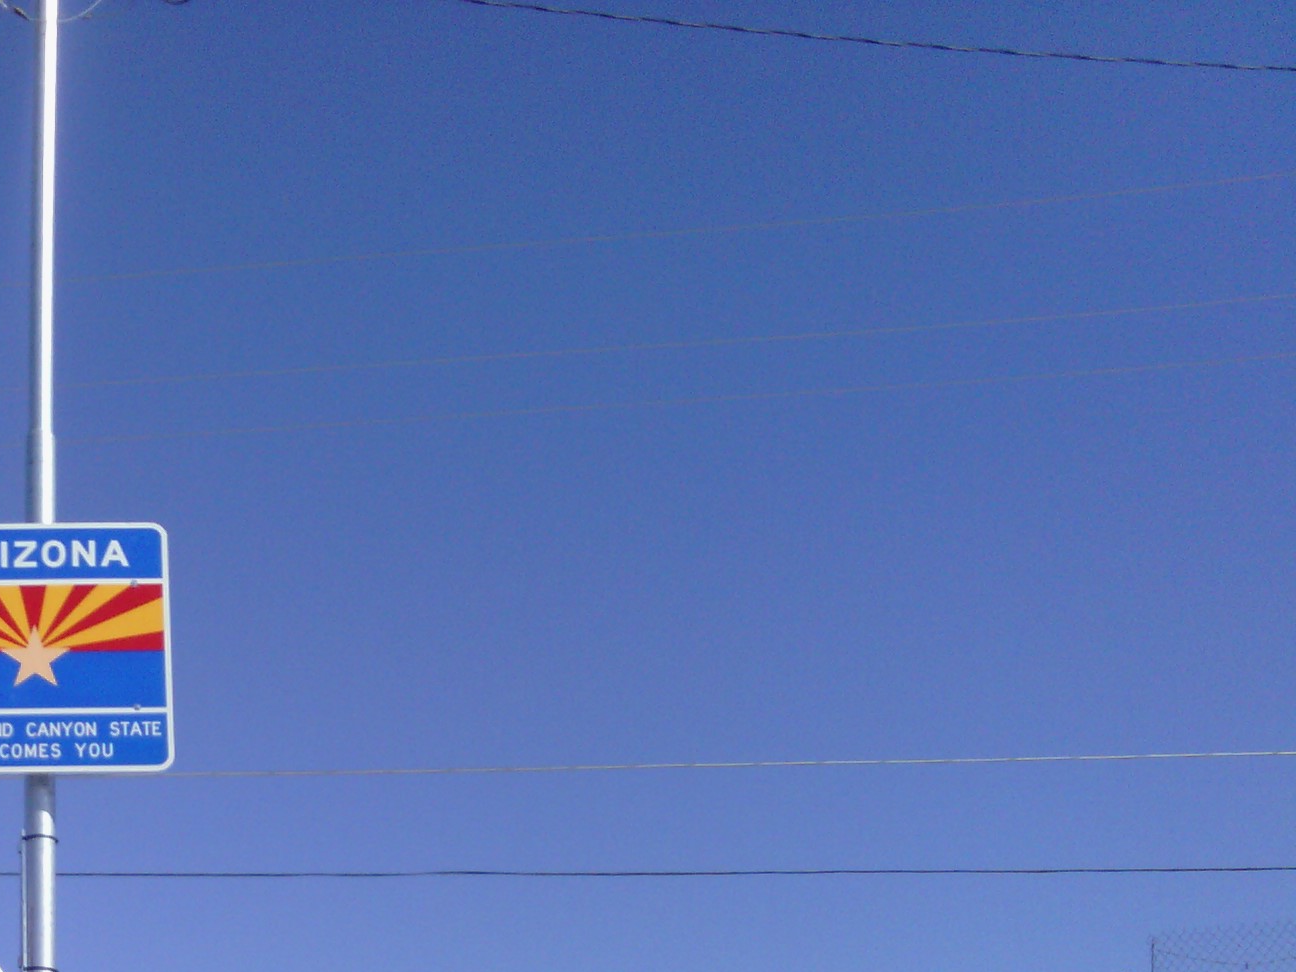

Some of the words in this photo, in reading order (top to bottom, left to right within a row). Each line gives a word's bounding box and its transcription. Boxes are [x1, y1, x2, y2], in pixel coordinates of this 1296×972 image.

[26, 721, 97, 737] CANYON
[110, 720, 161, 737] STATE
[75, 742, 114, 758] YOU
